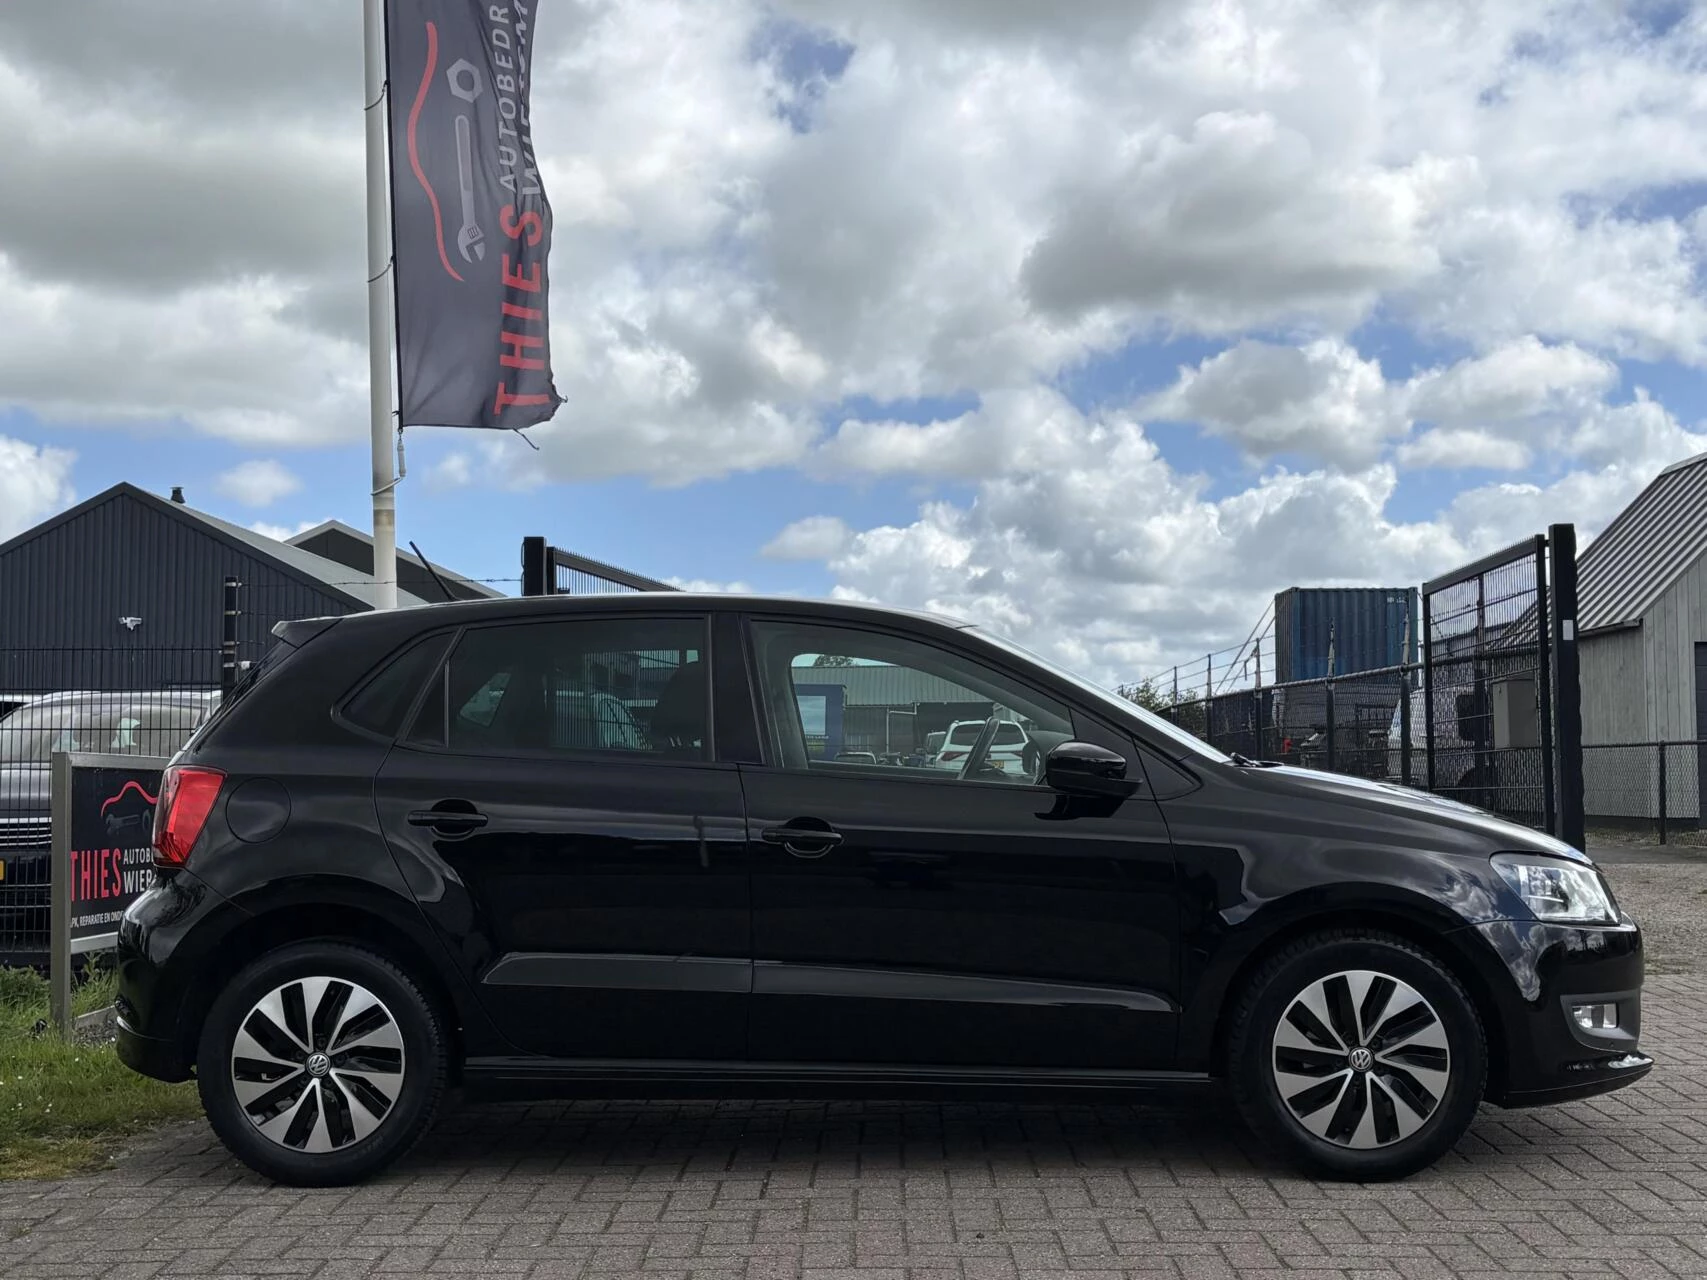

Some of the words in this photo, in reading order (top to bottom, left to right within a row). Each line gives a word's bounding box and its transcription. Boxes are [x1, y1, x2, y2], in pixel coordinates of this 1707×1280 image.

[490, 4, 517, 192] AUTOBEDR
[494, 204, 550, 415] THIES
[70, 848, 121, 902] THIES
[70, 917, 79, 928] PK,
[79, 913, 104, 927] REPARATIE
[104, 912, 111, 923] EN
